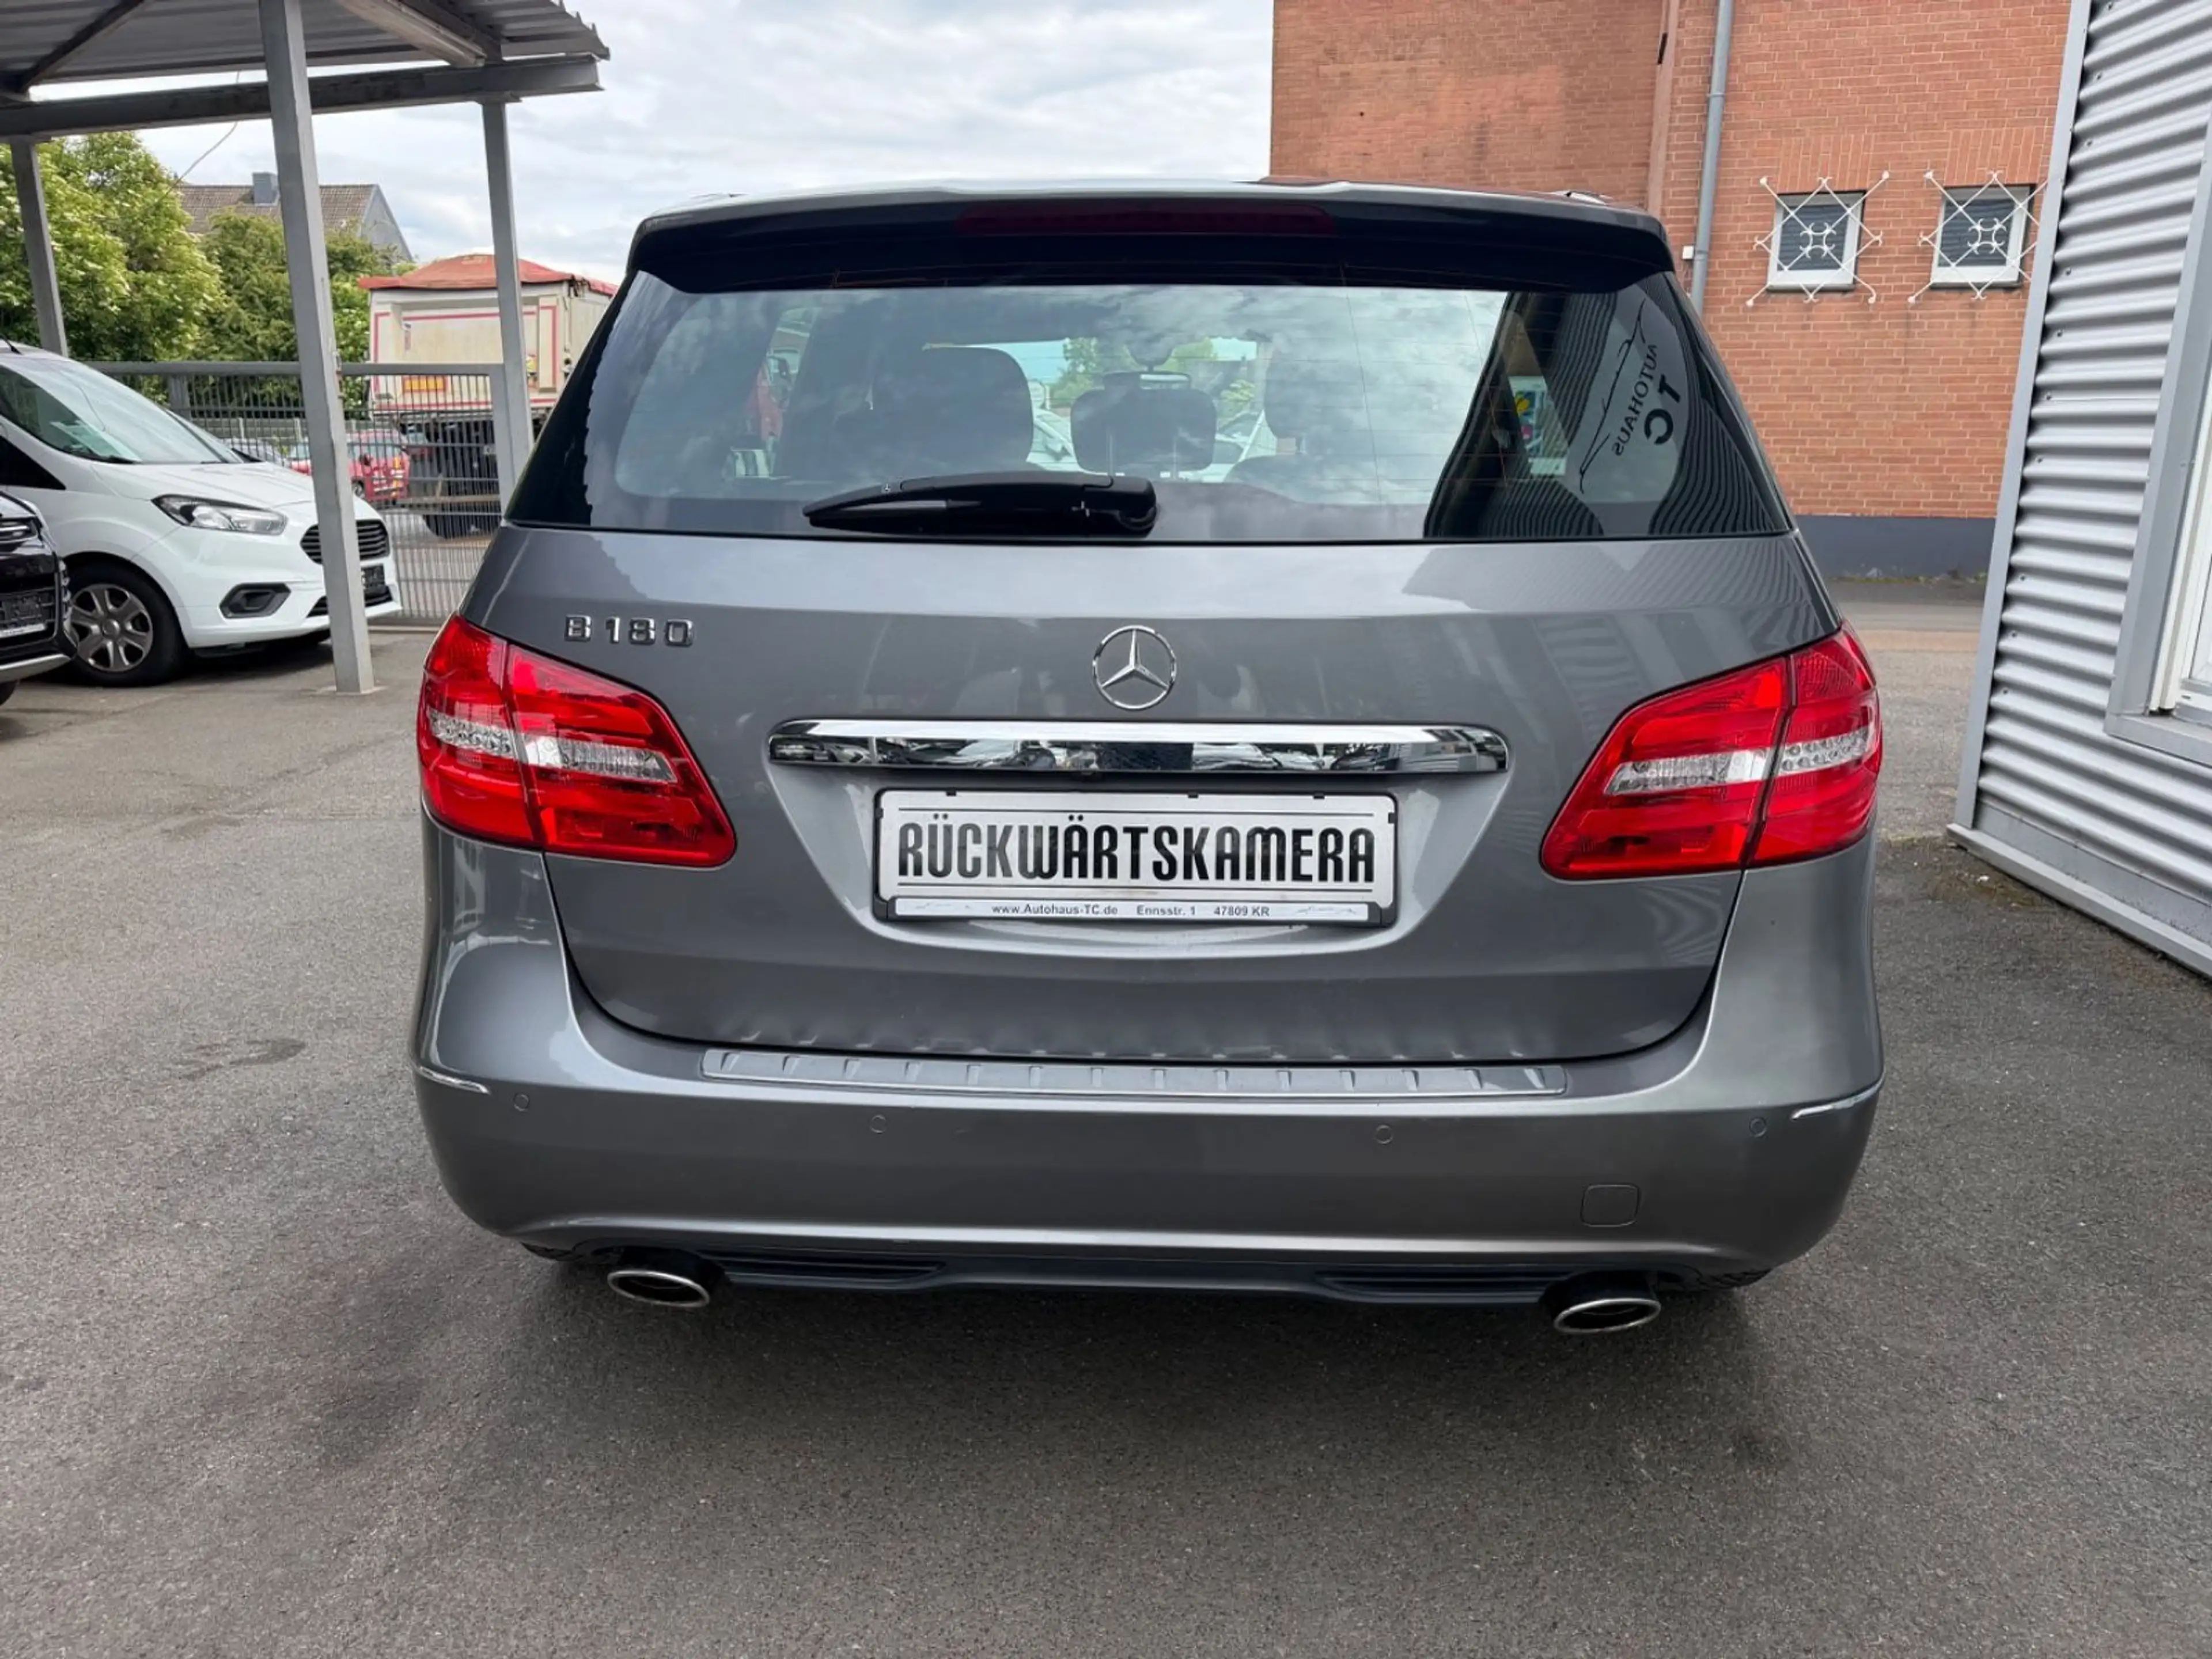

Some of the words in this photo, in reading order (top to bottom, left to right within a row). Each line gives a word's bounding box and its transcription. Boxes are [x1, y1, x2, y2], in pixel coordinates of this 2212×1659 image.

[564, 613, 592, 642] B
[605, 615, 695, 647] 180
[898, 813, 1375, 883] RÜCKWÄRTSKAMERA
[991, 903, 1118, 915] www.Autohaus-TC.de
[1136, 904, 1185, 916] Ennsstr.
[1190, 905, 1196, 916] 1
[1213, 906, 1249, 917] 47809
[1251, 906, 1270, 917] KR
